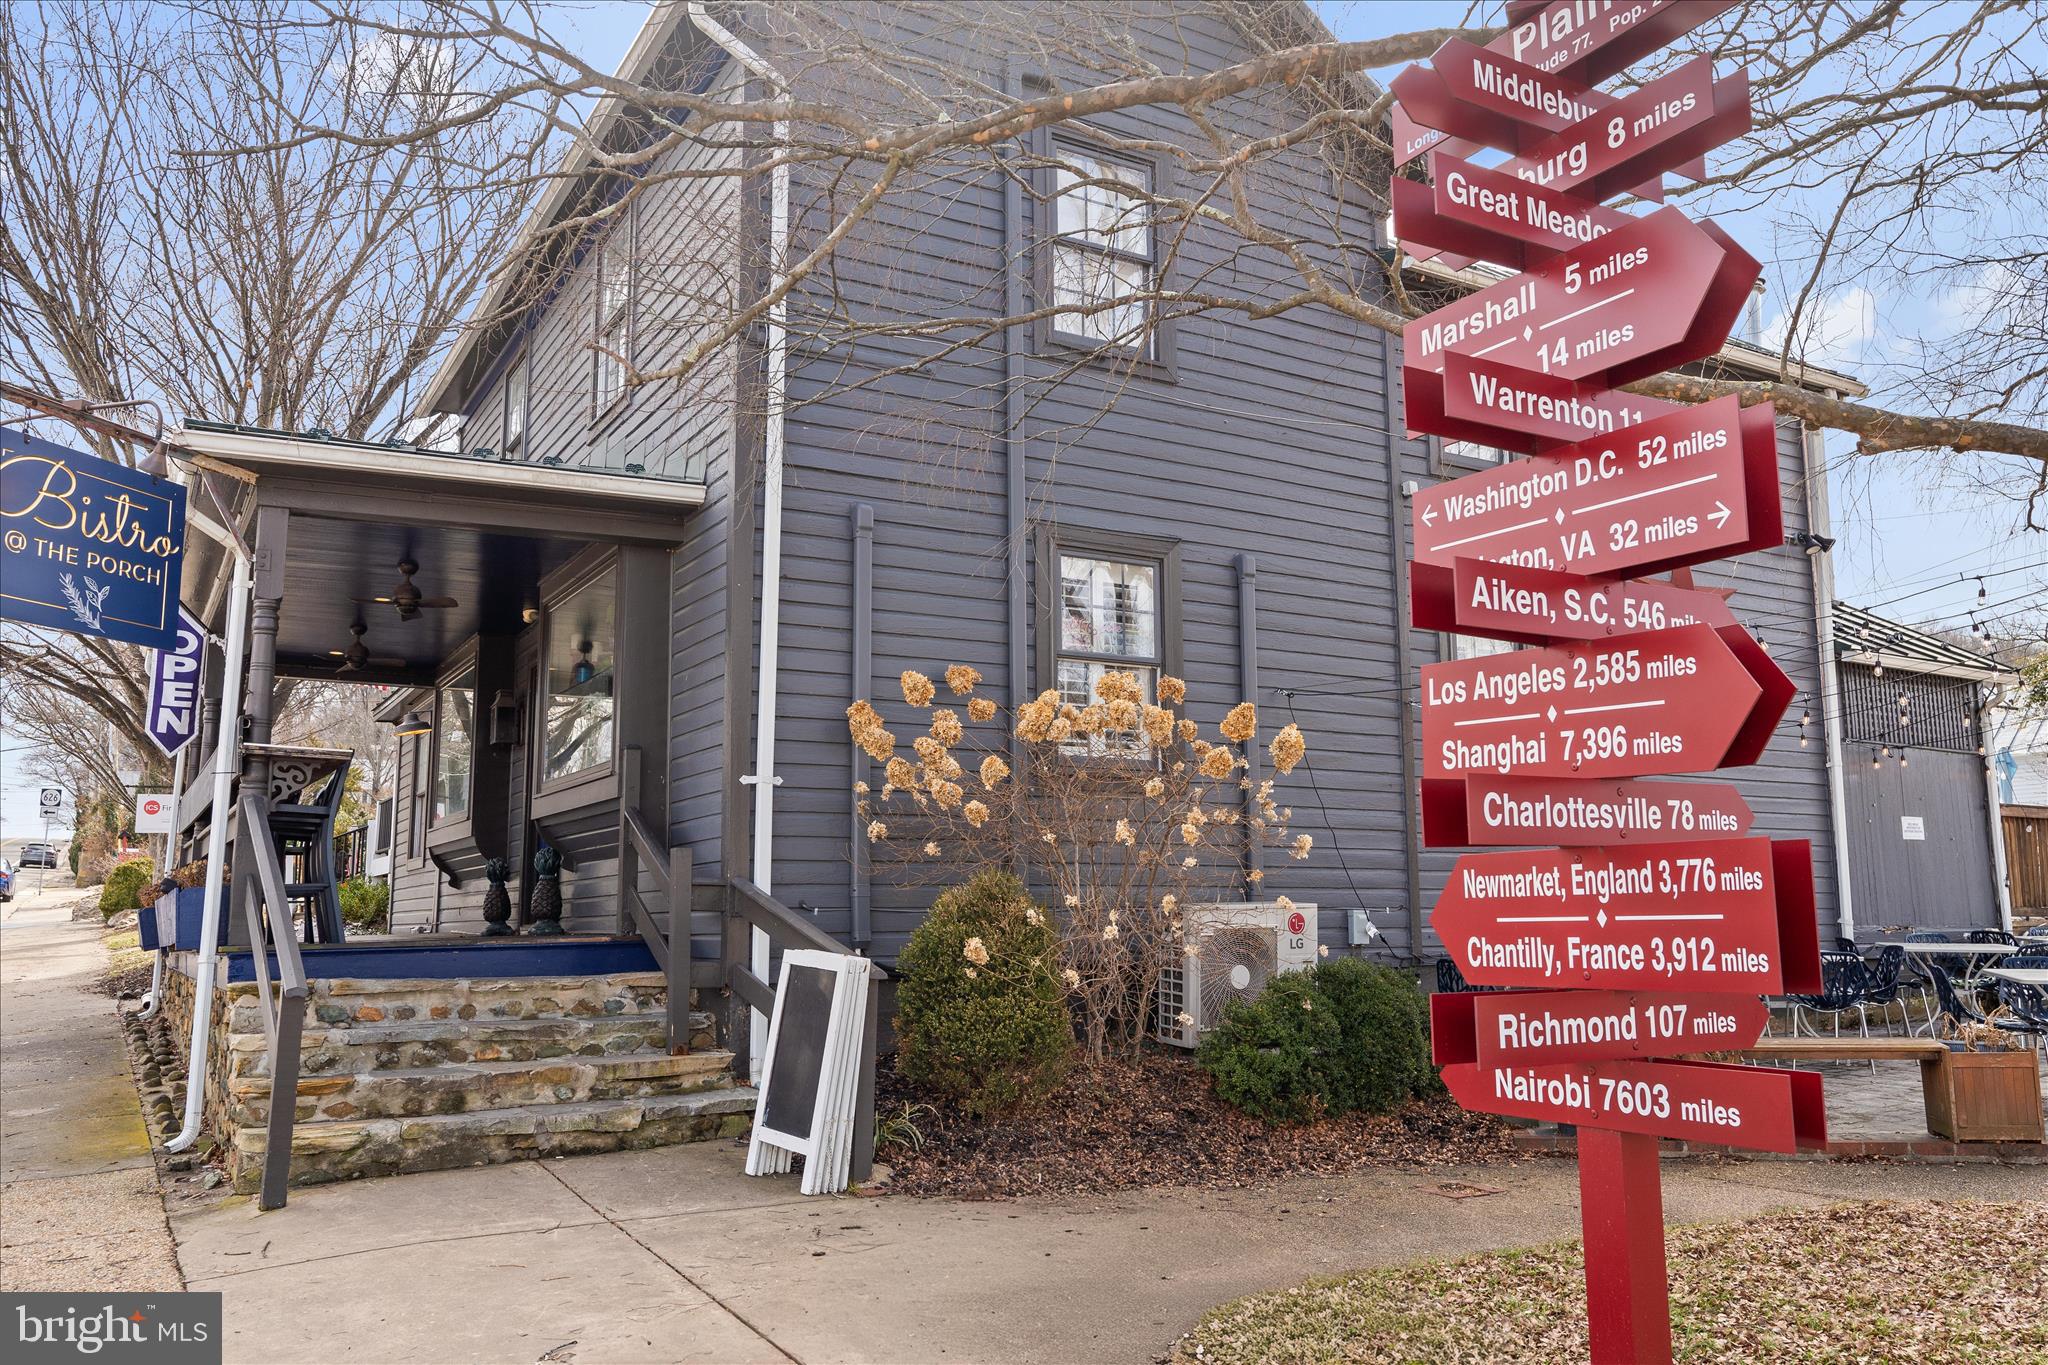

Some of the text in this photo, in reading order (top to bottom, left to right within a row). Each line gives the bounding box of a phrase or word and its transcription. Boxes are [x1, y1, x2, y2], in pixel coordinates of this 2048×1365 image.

[1609, 5, 1647, 32] Pop.
[1407, 129, 1442, 154] Long
[1607, 117, 1626, 149] 8
[1634, 91, 1697, 138] miles
[1446, 172, 1519, 221] Great
[1421, 246, 1649, 356] Marshall 5 miles
[1536, 324, 1634, 373] 14 miles
[1469, 372, 1613, 432] Warrenton
[1444, 429, 1727, 522] Washington D.C. 52 miles
[0, 455, 180, 557] Bistro
[5, 530, 161, 586] @ THE PORCH
[1560, 530, 1596, 561] VA
[1609, 520, 1639, 551] 32
[1645, 515, 1698, 544] miles
[1471, 577, 1555, 623] Aiken,
[1564, 589, 1616, 626] S.C.
[1624, 598, 1665, 630] 546
[156, 630, 199, 734] OPEN
[1429, 650, 1697, 706] Los Angeles 2,585 miles
[1442, 725, 1682, 773] Shanghai 7,396 miles
[43, 793, 58, 802] 626
[1483, 792, 1738, 831] Charlottesville 78 miles
[1463, 858, 1763, 903] Newmarket, England 3,776 miles
[1289, 937, 1304, 949] LG
[1467, 936, 1769, 977] Chantilly, France 3,912 miles
[1498, 1005, 1736, 1049] Richmond 107 miles
[1495, 1069, 1740, 1128] Nairobi 7603 miles
